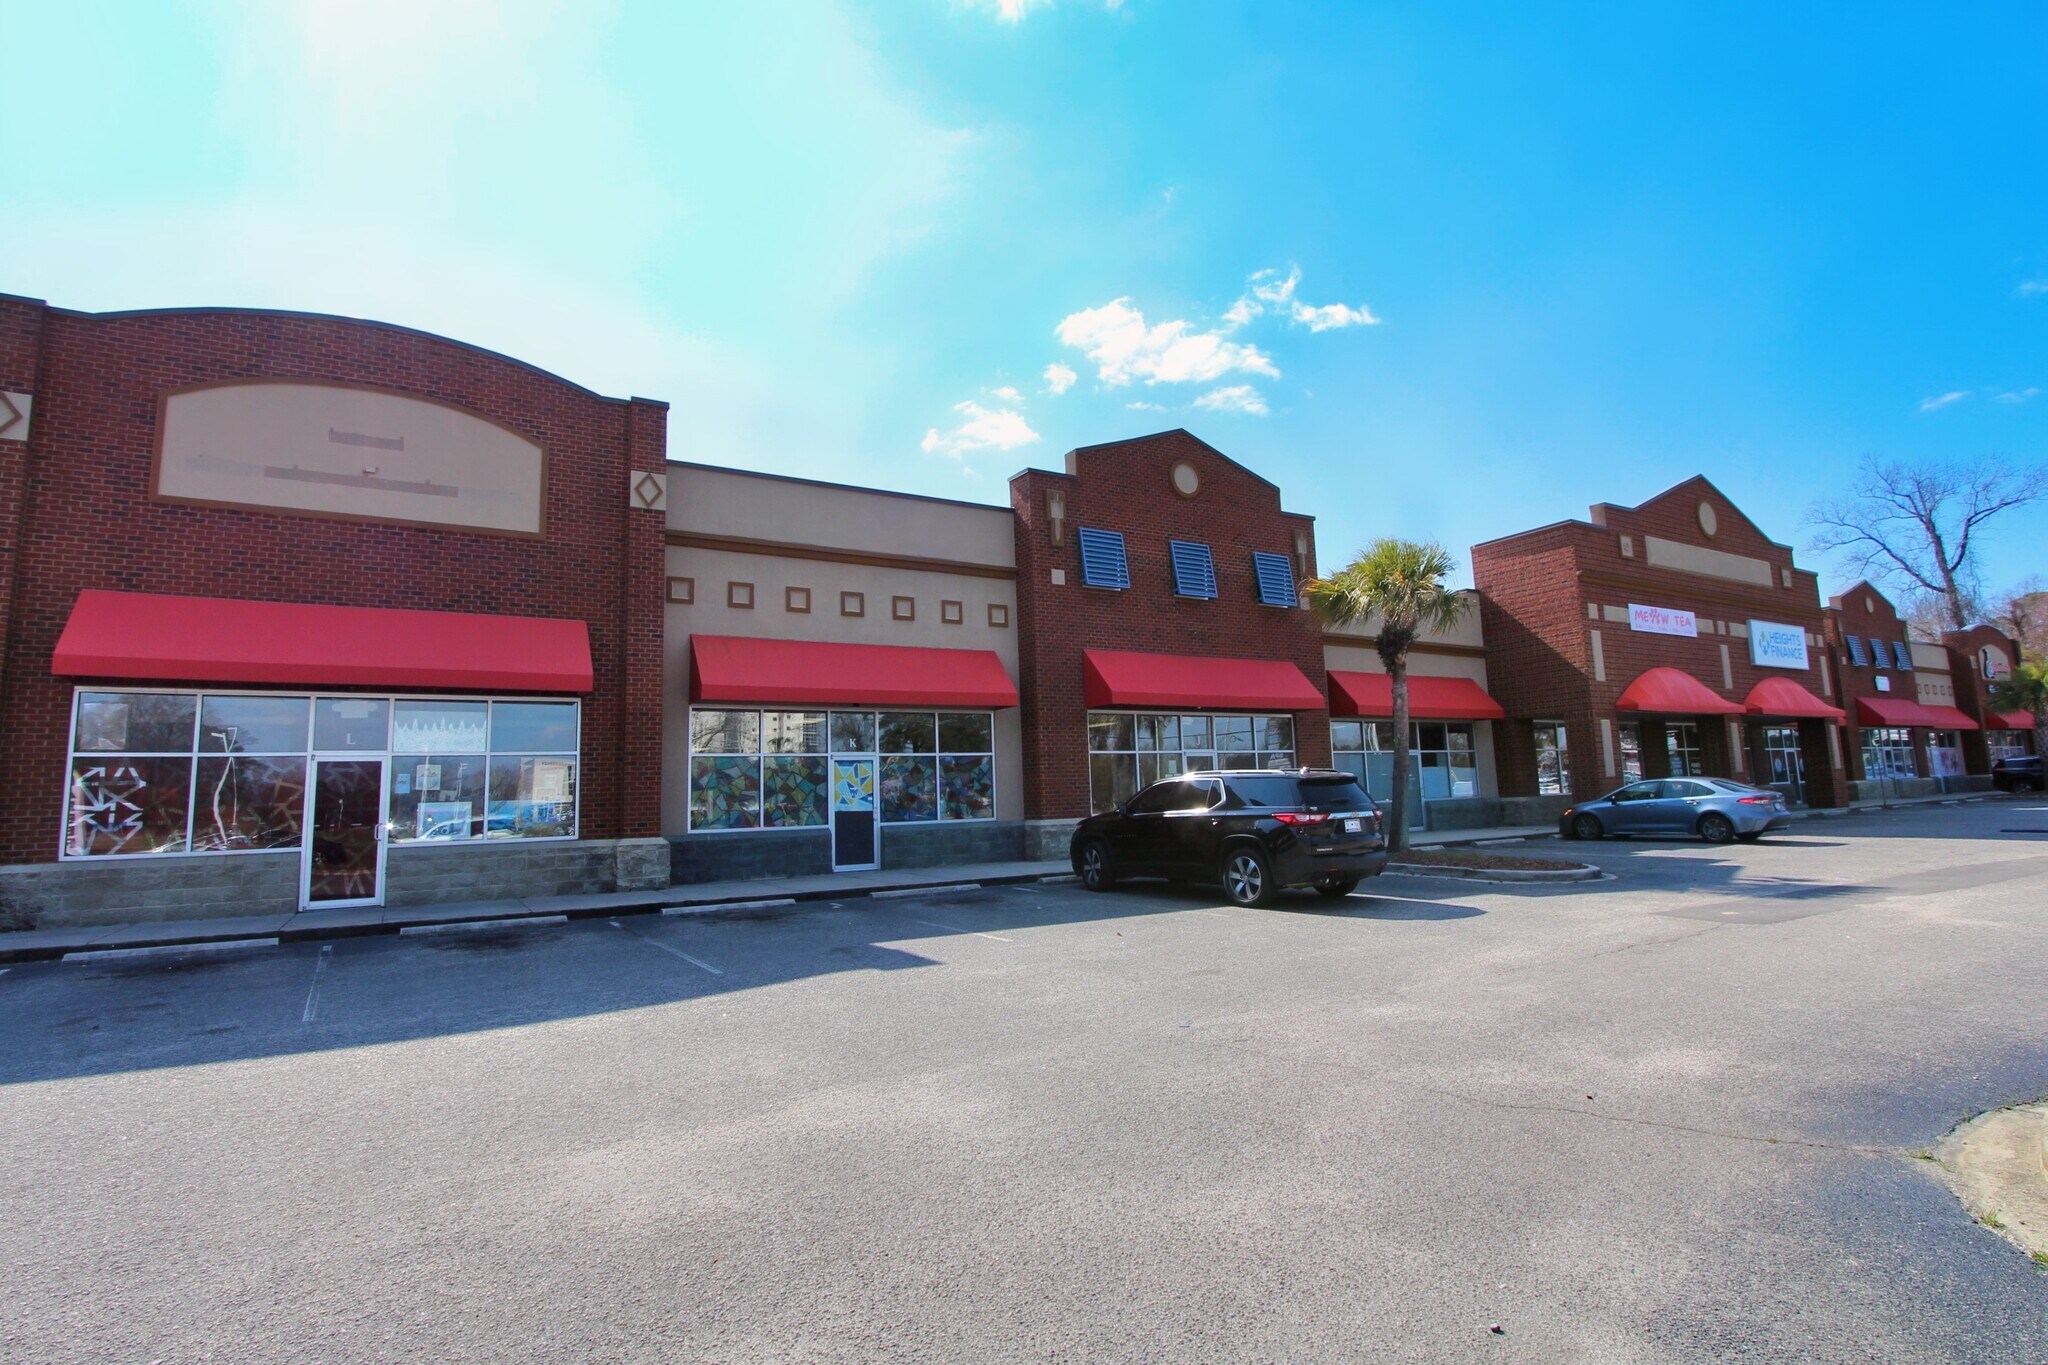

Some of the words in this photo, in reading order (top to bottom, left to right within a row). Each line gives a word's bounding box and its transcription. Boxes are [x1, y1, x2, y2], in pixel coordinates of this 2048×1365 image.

[1674, 615, 1692, 627] TEA
[1769, 631, 1801, 646] HEIGHTS
[1771, 645, 1803, 660] FINANCE
[346, 733, 356, 744] L
[849, 738, 857, 748] K
